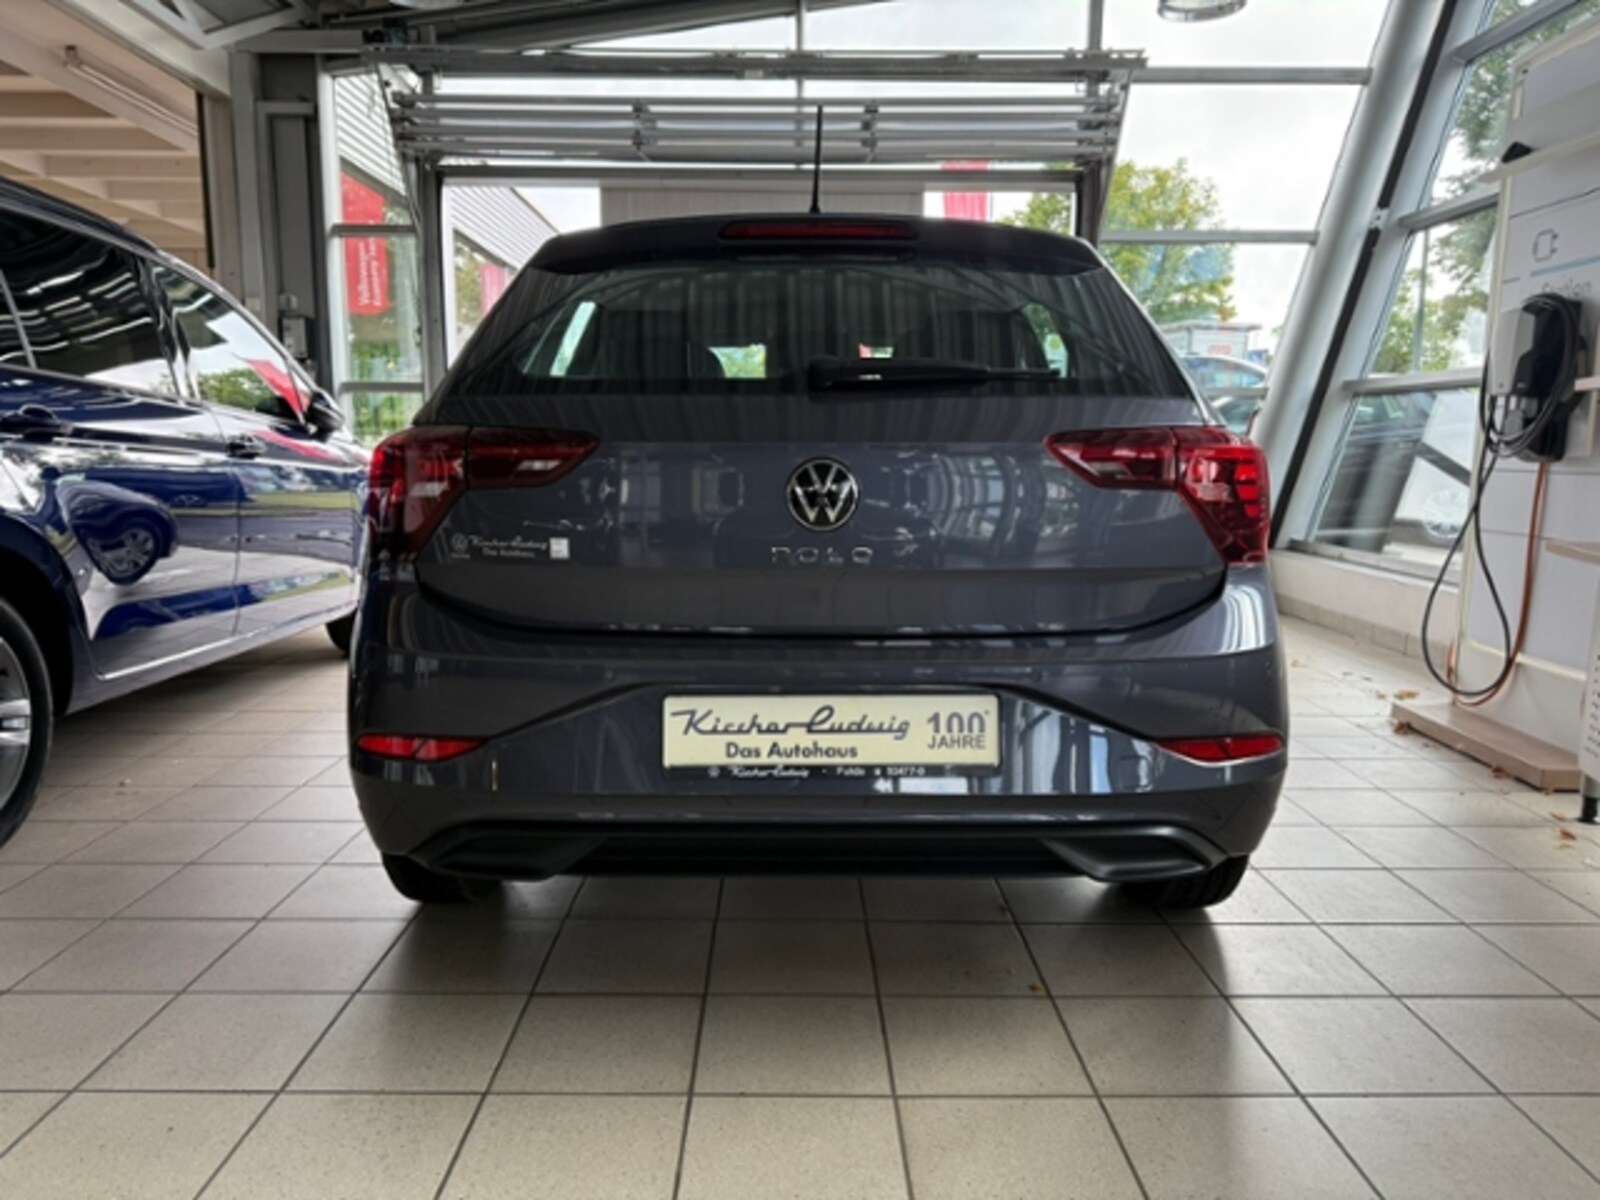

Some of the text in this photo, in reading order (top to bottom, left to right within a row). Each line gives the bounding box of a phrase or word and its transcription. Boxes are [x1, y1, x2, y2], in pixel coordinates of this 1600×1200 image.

[725, 740, 858, 758] Das Autohaus
[927, 735, 986, 750] JAHRE
